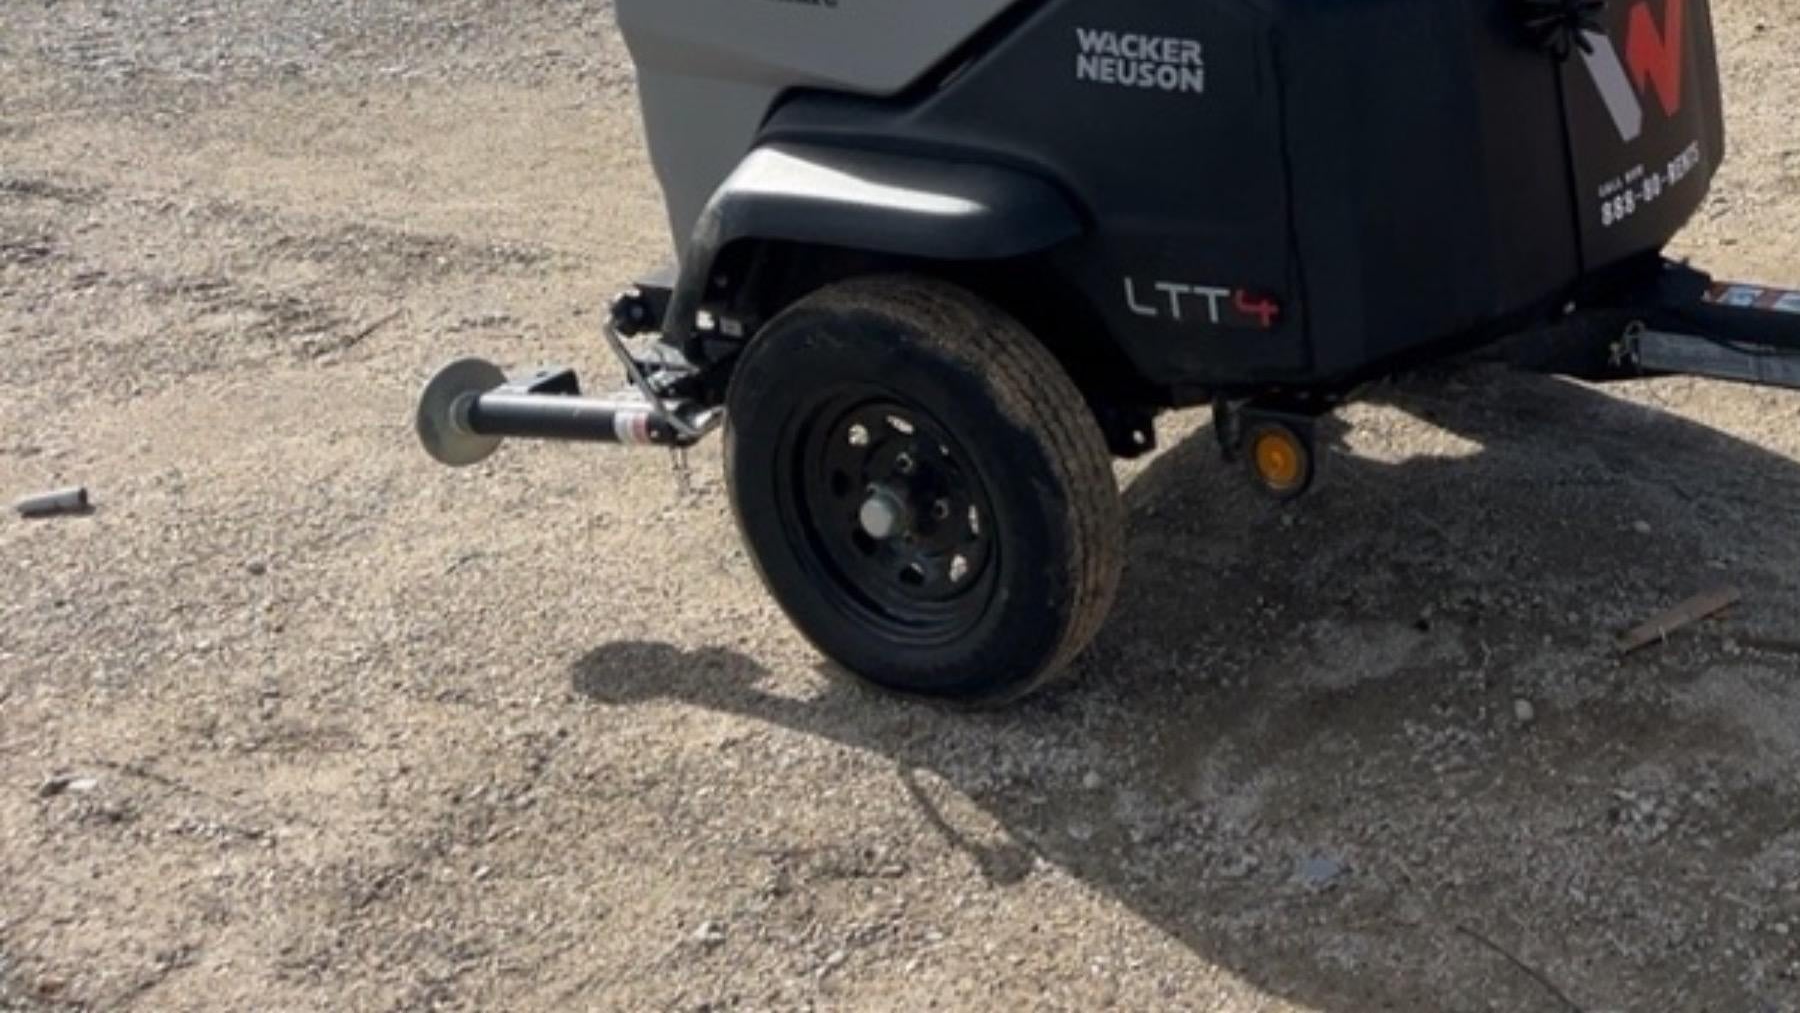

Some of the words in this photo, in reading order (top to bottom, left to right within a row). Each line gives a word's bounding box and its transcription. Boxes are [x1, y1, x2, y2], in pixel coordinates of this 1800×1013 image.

[1076, 27, 1204, 66] WACKER
[1076, 54, 1204, 93] NEUSON
[1124, 276, 1280, 327] LTT4
